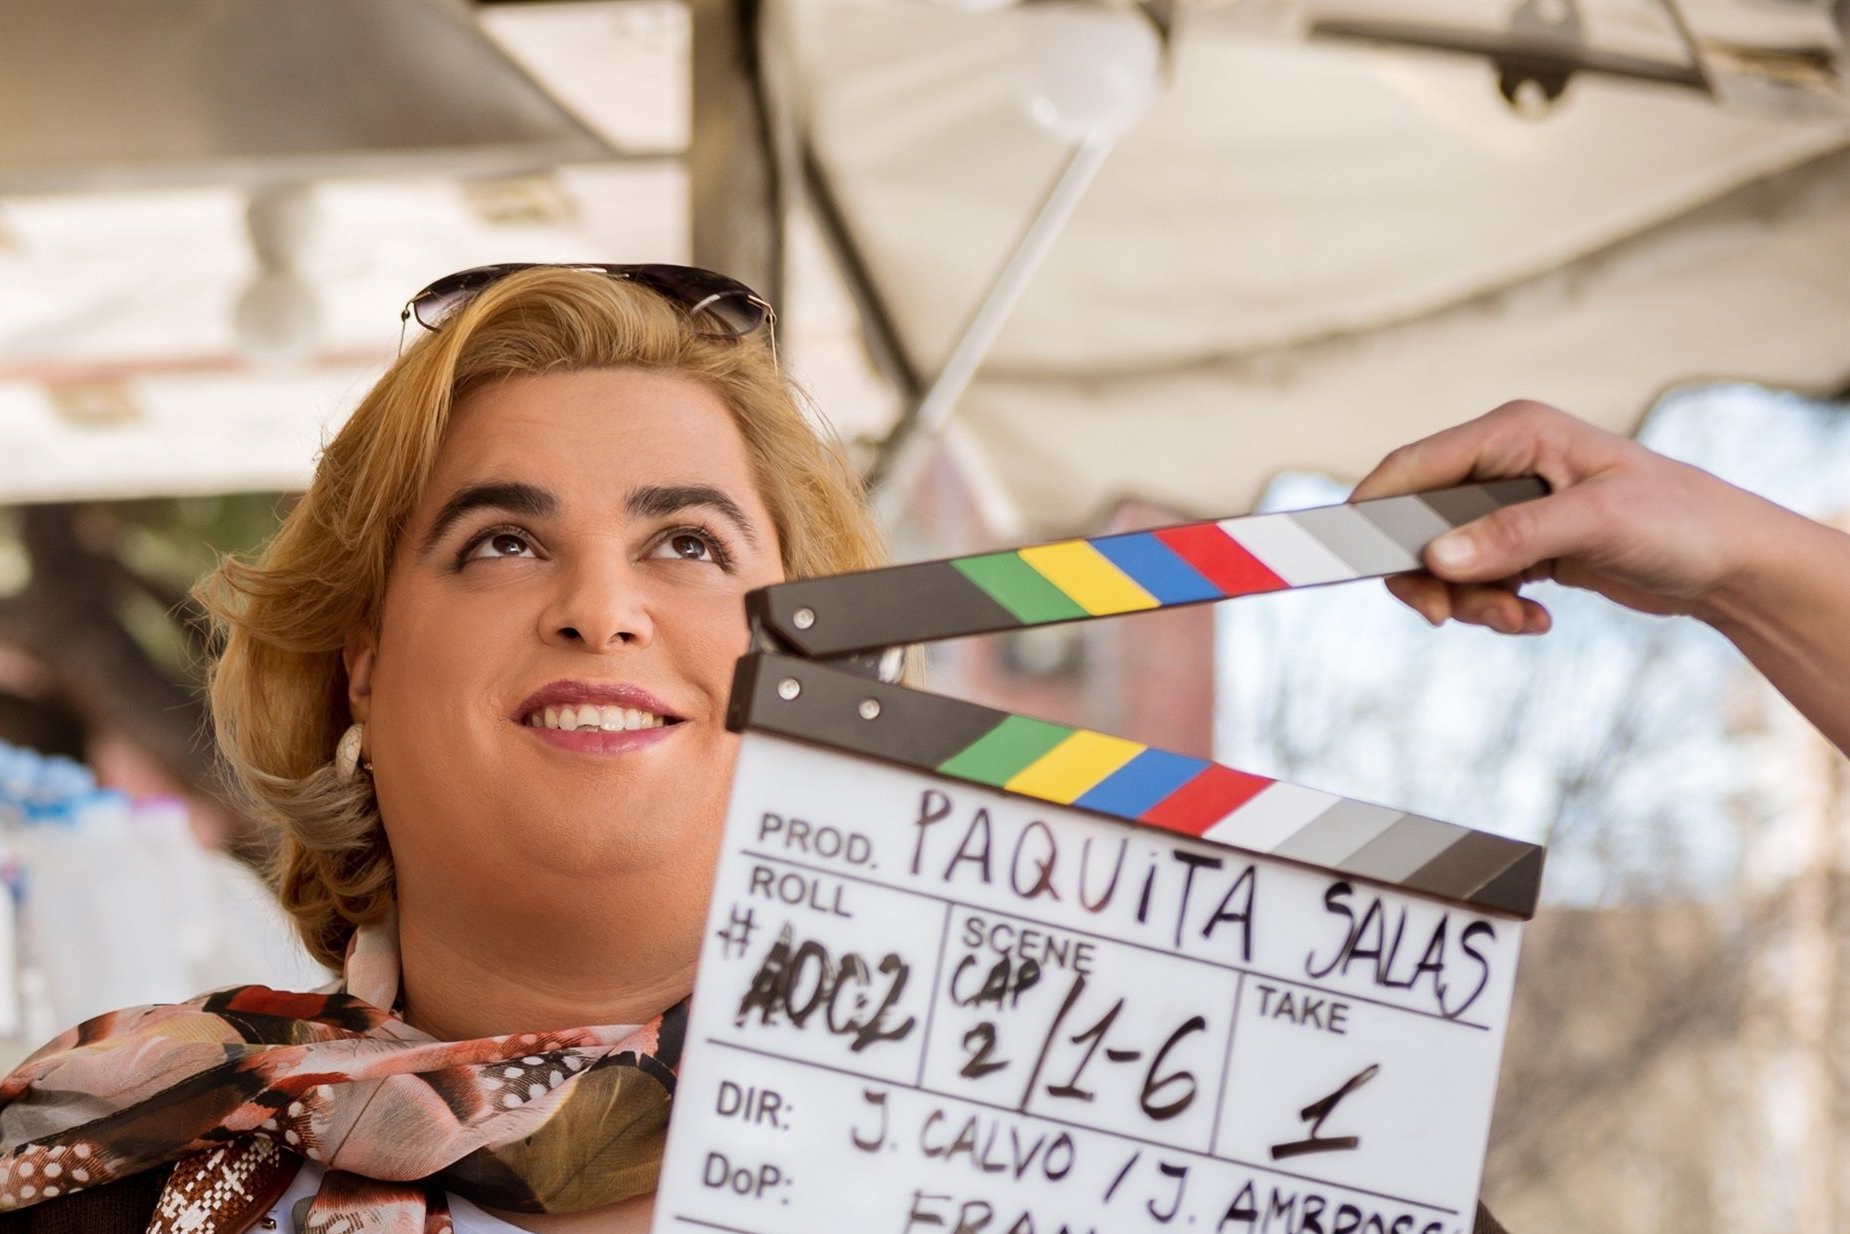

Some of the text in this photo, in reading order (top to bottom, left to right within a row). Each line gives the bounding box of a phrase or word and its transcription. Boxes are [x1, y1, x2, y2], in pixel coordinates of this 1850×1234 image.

[756, 811, 878, 871] PROD.
[749, 864, 854, 919] ROLL
[962, 916, 1098, 974] SCENE
[1304, 880, 1496, 1019] SALAS
[1256, 984, 1350, 1035] TAKE
[958, 1021, 1011, 1079] 2
[715, 1080, 794, 1131] DIR:
[1270, 1062, 1381, 1160] 1
[918, 1109, 1077, 1183] CALVO
[702, 1152, 794, 1206] DoP:
